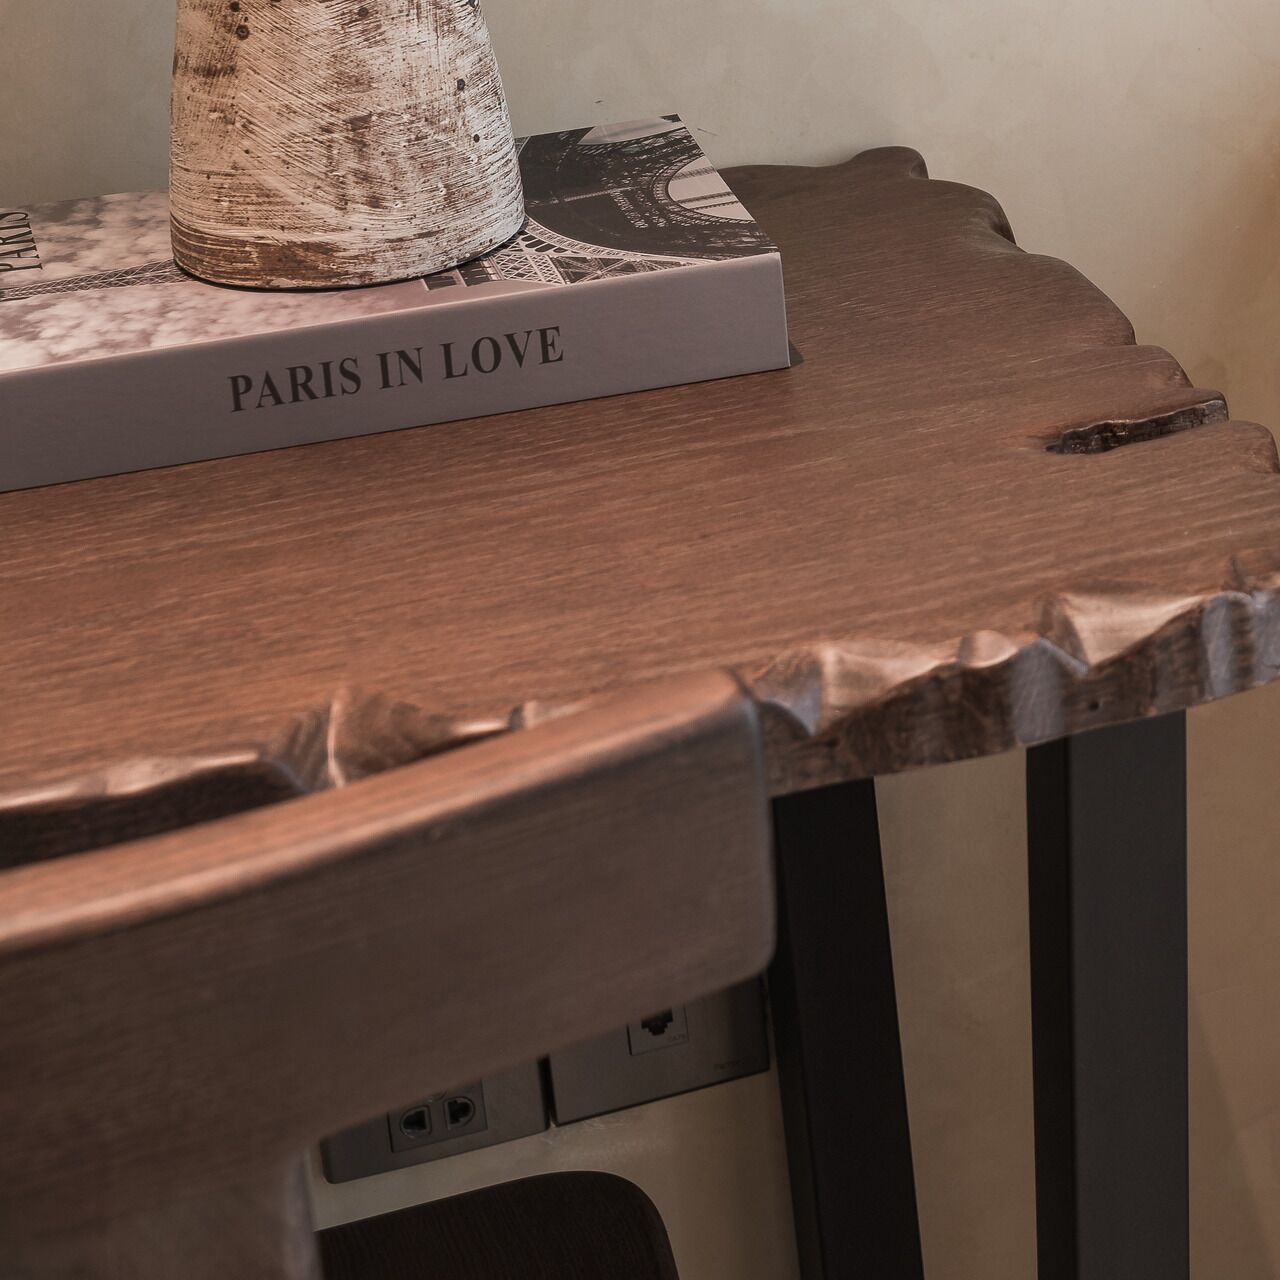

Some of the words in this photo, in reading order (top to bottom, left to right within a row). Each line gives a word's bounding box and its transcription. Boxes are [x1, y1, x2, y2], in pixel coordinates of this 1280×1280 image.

[227, 357, 362, 412] PARIS
[376, 347, 425, 389] IN
[440, 326, 564, 379] LOVE
